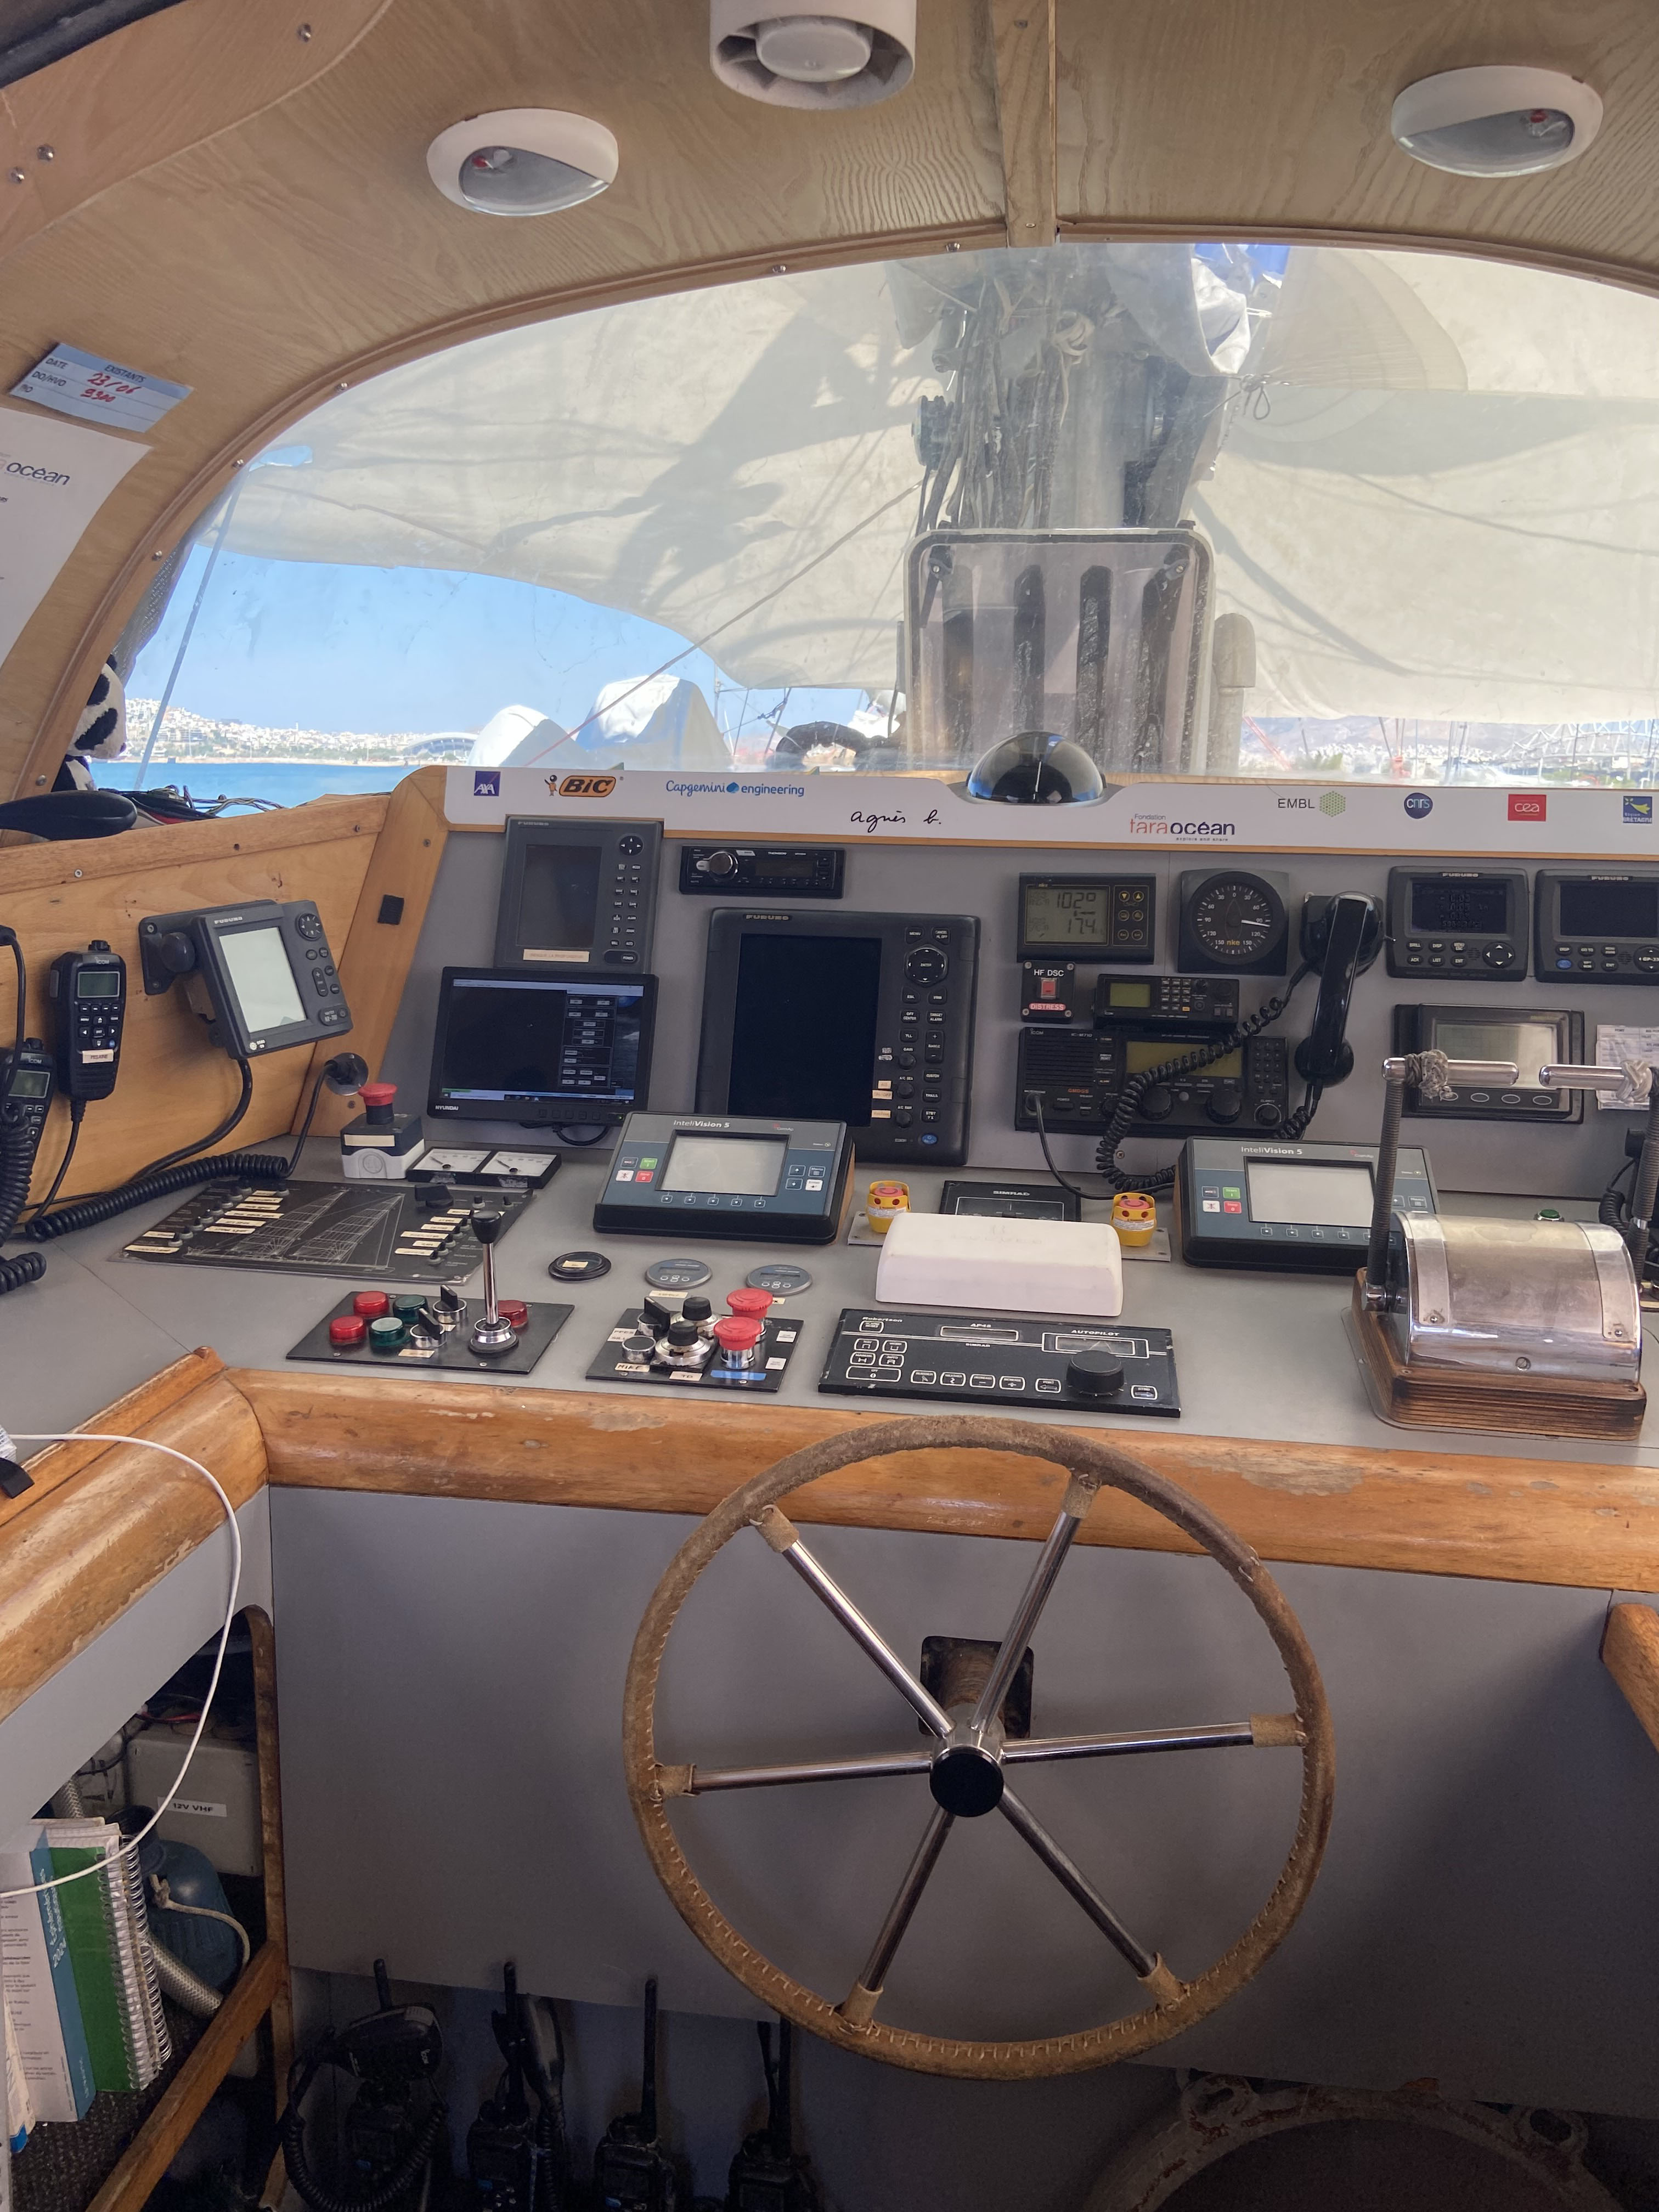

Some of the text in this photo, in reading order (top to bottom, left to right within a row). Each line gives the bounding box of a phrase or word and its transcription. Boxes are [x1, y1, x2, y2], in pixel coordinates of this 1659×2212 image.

[45, 358, 69, 369] DATE
[104, 364, 146, 383] EXISTANTS
[474, 783, 495, 794] AXA
[665, 780, 804, 797] Capgemini engineering
[1278, 798, 1315, 810] EMBL
[1406, 798, 1430, 809] cnrs
[1514, 803, 1540, 812] cea
[1241, 1146, 1294, 1154] InteliVision
